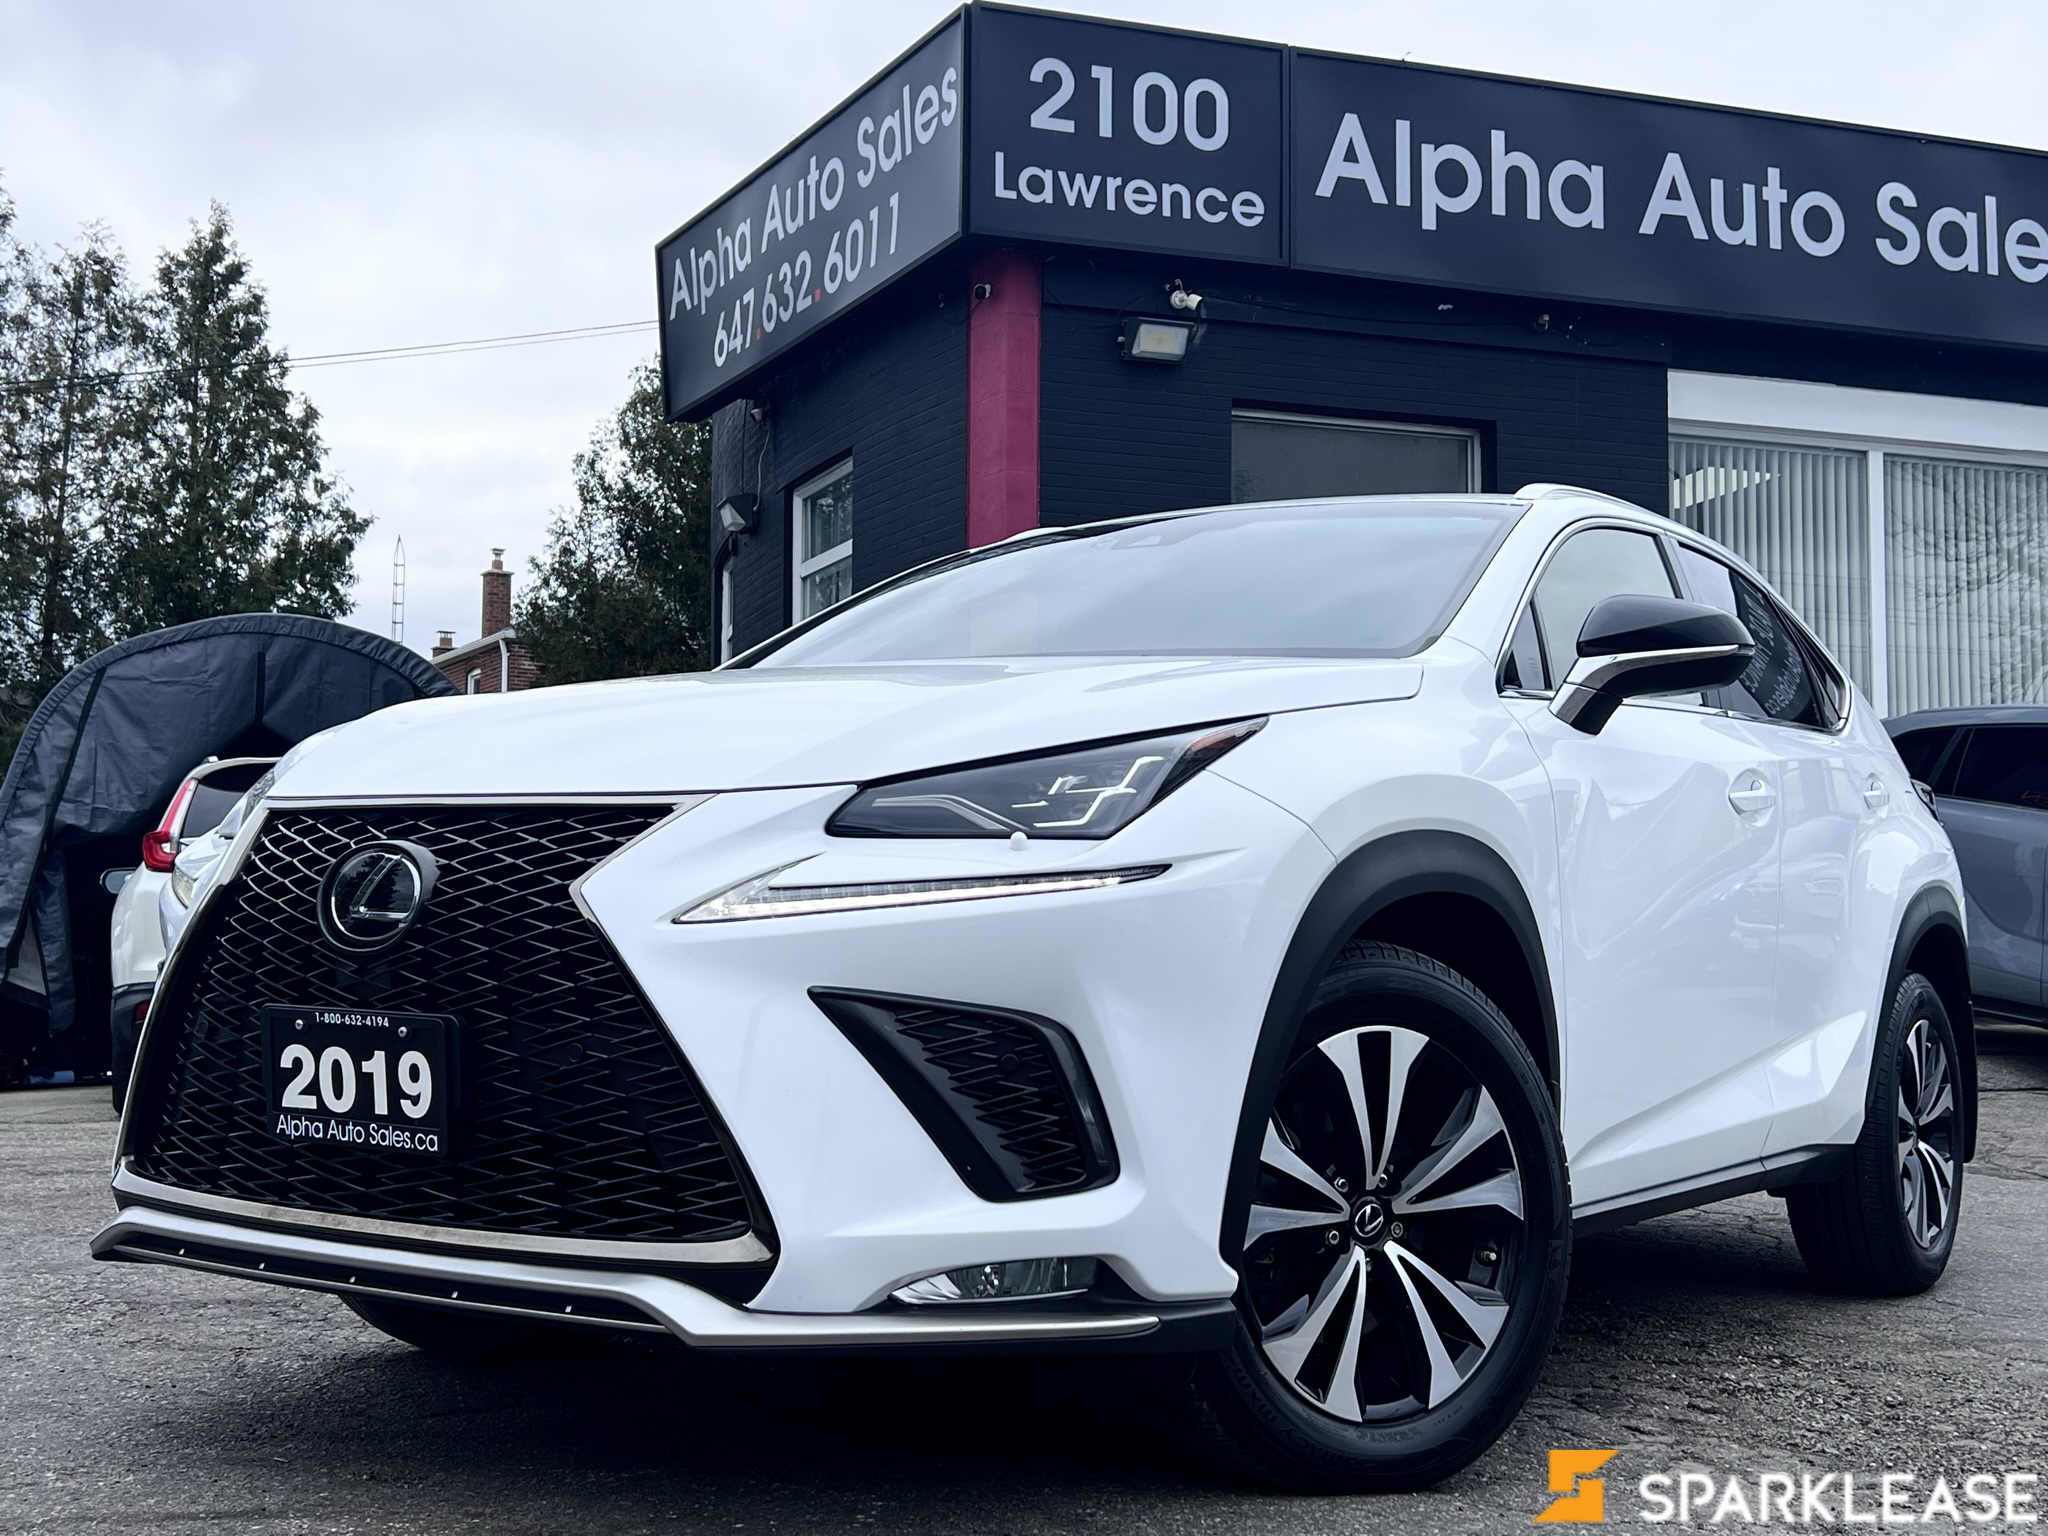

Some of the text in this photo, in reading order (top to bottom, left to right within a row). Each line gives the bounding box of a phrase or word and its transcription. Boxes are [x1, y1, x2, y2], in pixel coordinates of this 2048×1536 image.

[1029, 57, 1229, 151] 2100
[669, 66, 958, 321] Alpha Auto Sales
[995, 151, 1265, 227] Lawrence
[1315, 112, 1605, 231] Alpha
[1638, 152, 1846, 258] Auto
[713, 191, 900, 368] 647.632.6011
[314, 1011, 390, 1028] 1-800-632-4194
[279, 1043, 433, 1119] 2019
[276, 1114, 438, 1152] Alpha Auto Sales.ca
